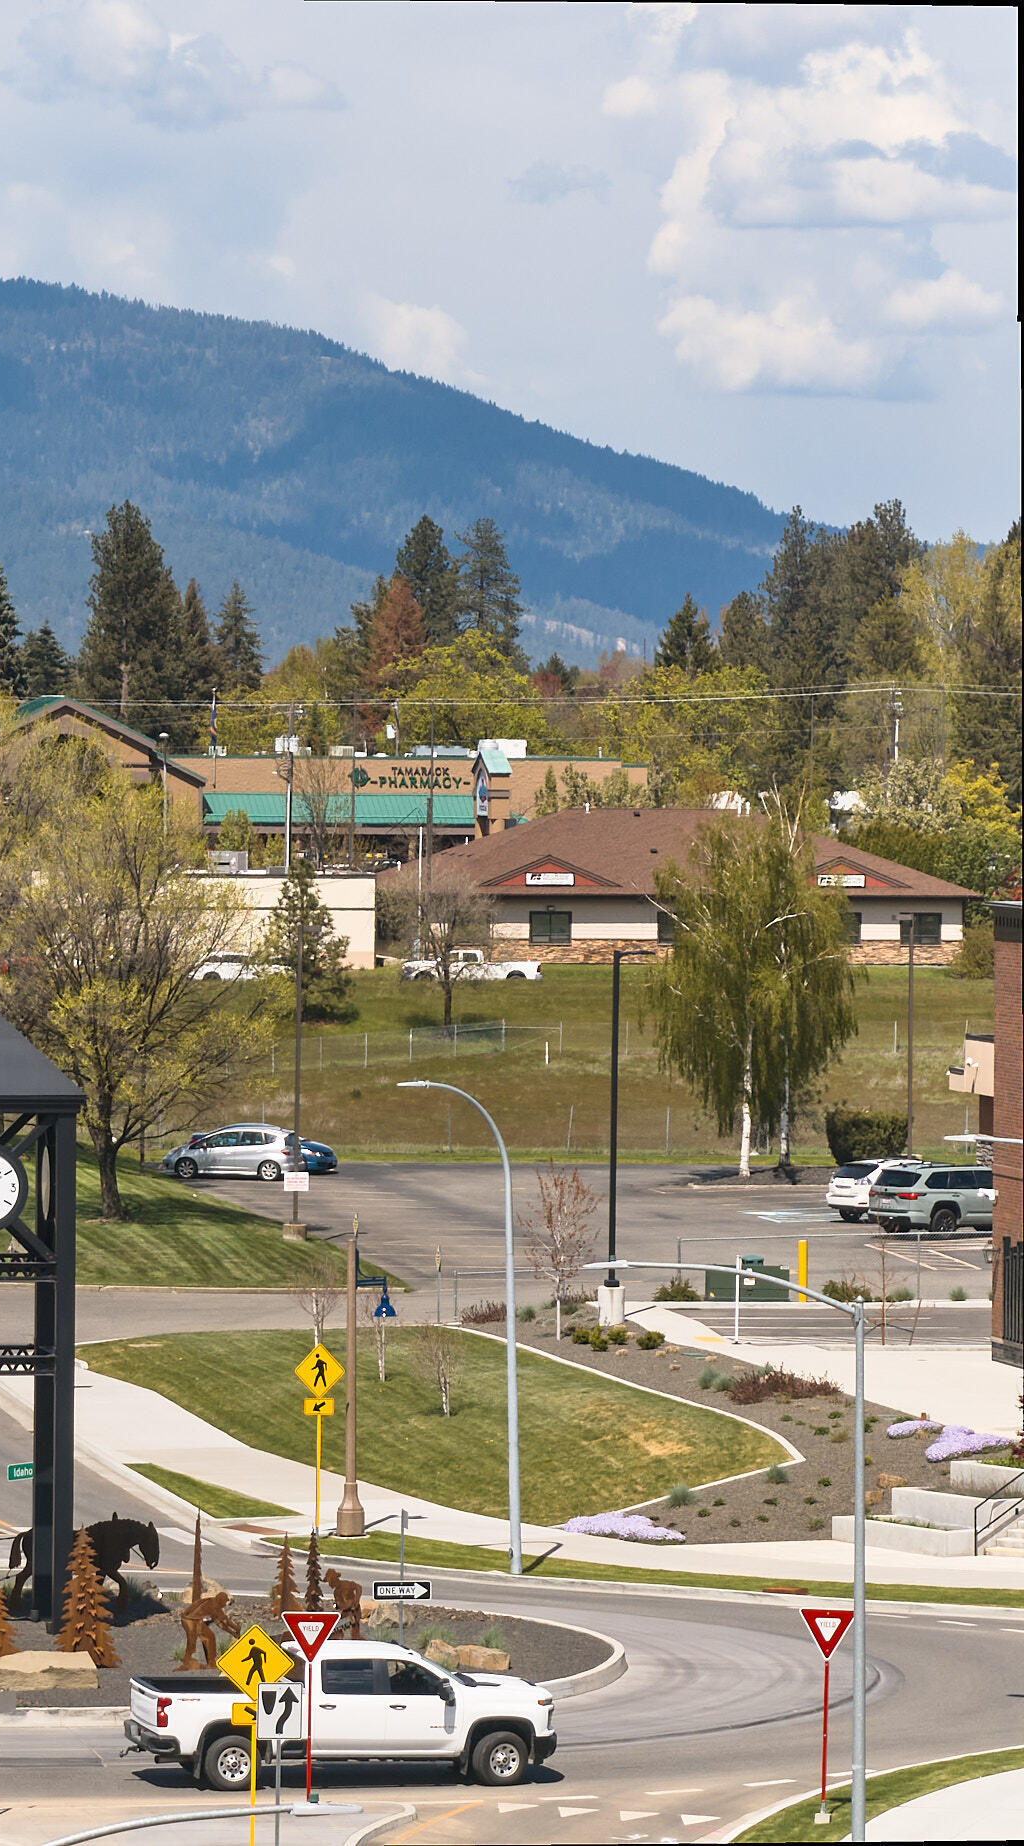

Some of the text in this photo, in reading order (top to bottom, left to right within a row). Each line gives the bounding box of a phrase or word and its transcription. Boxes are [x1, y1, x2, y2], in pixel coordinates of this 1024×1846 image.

[391, 766, 450, 777] TAMARACK
[10, 1183, 17, 1193] 3
[13, 1466, 33, 1478] Idaho
[379, 1587, 416, 1595] ONE WAY
